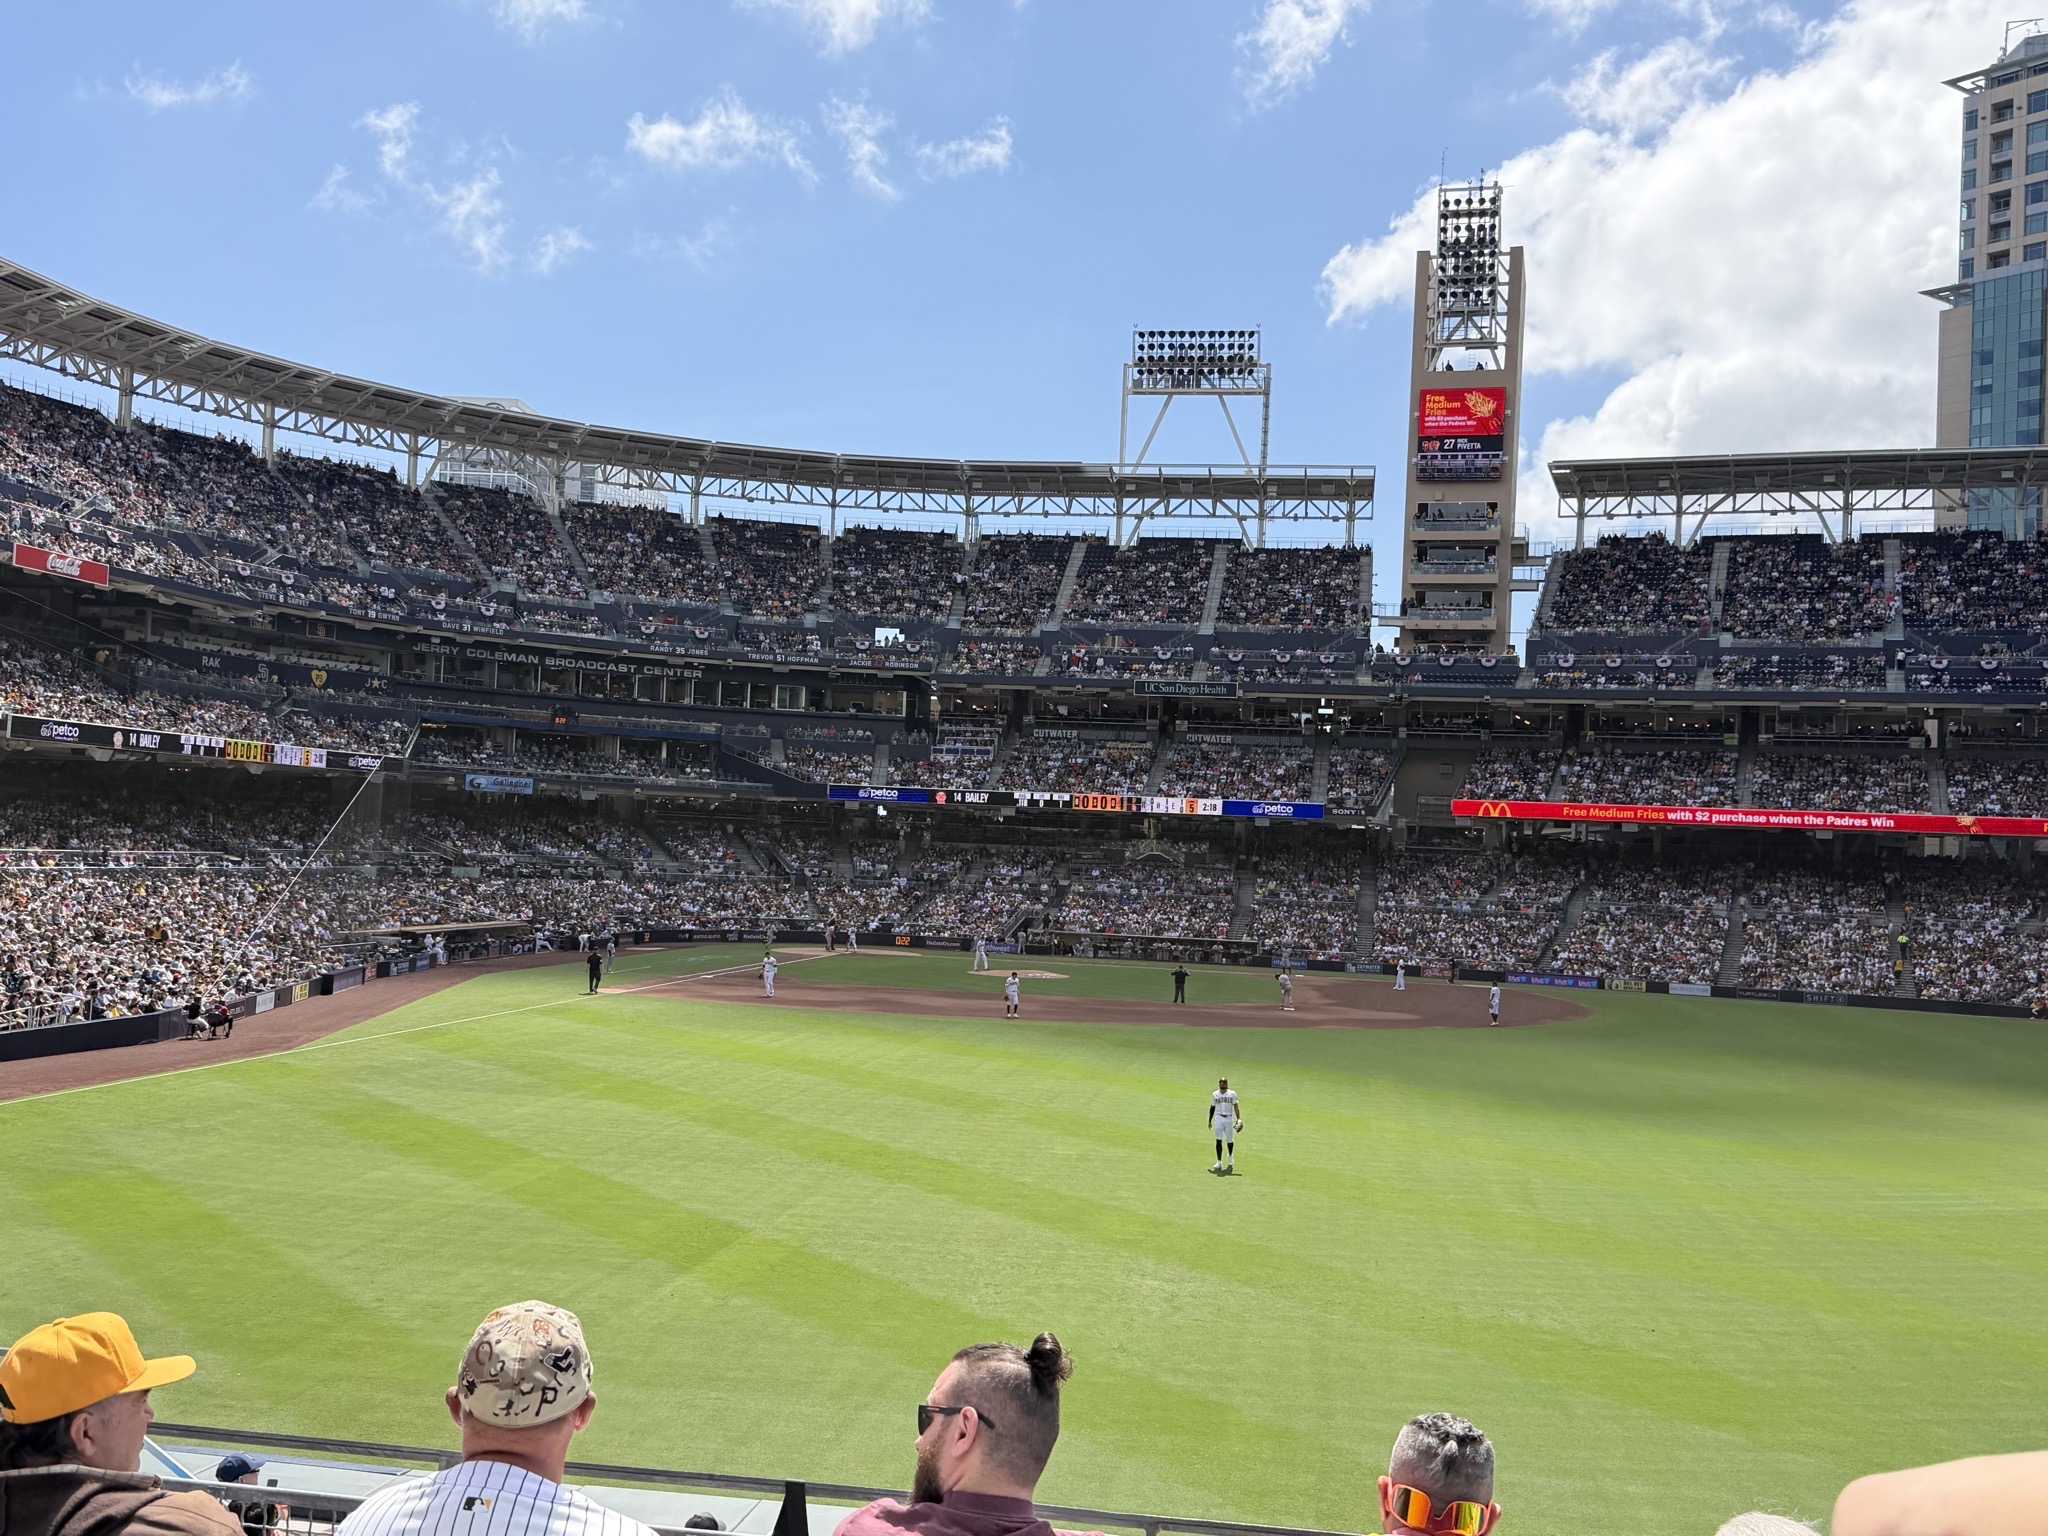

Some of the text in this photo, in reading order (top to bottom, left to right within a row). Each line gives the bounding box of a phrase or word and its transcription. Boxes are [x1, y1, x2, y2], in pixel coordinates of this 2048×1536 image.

[1426, 394, 1445, 402] Free
[1426, 408, 1446, 416] Fries
[1444, 439, 1455, 450] 27
[279, 594, 284, 602] 6
[350, 608, 400, 622] TONY 19 GWYNN
[442, 622, 504, 635] DAVE 31 WINFIELD
[650, 645, 673, 653] RANDY
[687, 648, 709, 656] JONES
[202, 656, 220, 668] RAK
[413, 642, 702, 678] JERRY COLEMAN BROADCAST CENTER
[787, 656, 818, 664] HOFFMAN
[873, 660, 883, 668] 42
[316, 673, 324, 682] PS
[1145, 683, 1226, 695] UC San Diego Health
[53, 723, 79, 738] petco
[1034, 729, 1077, 738] CUTWATER
[129, 733, 161, 749] 14 BAILEY
[1186, 734, 1232, 743] CUTWATER
[358, 757, 381, 770] petco
[870, 788, 898, 798] petco
[954, 793, 989, 803] 14 BAILEY
[1082, 796, 1089, 808] 0
[1101, 796, 1107, 809] 0
[1189, 803, 1217, 813] 5 2:18
[1264, 804, 1293, 814] petco
[1563, 807, 1894, 827] Free Medium Fries with $2 purchase when the Padres Win
[1531, 976, 1544, 984] blue
[1578, 979, 1591, 987] blue
[1806, 994, 1835, 1003] SHIFT
